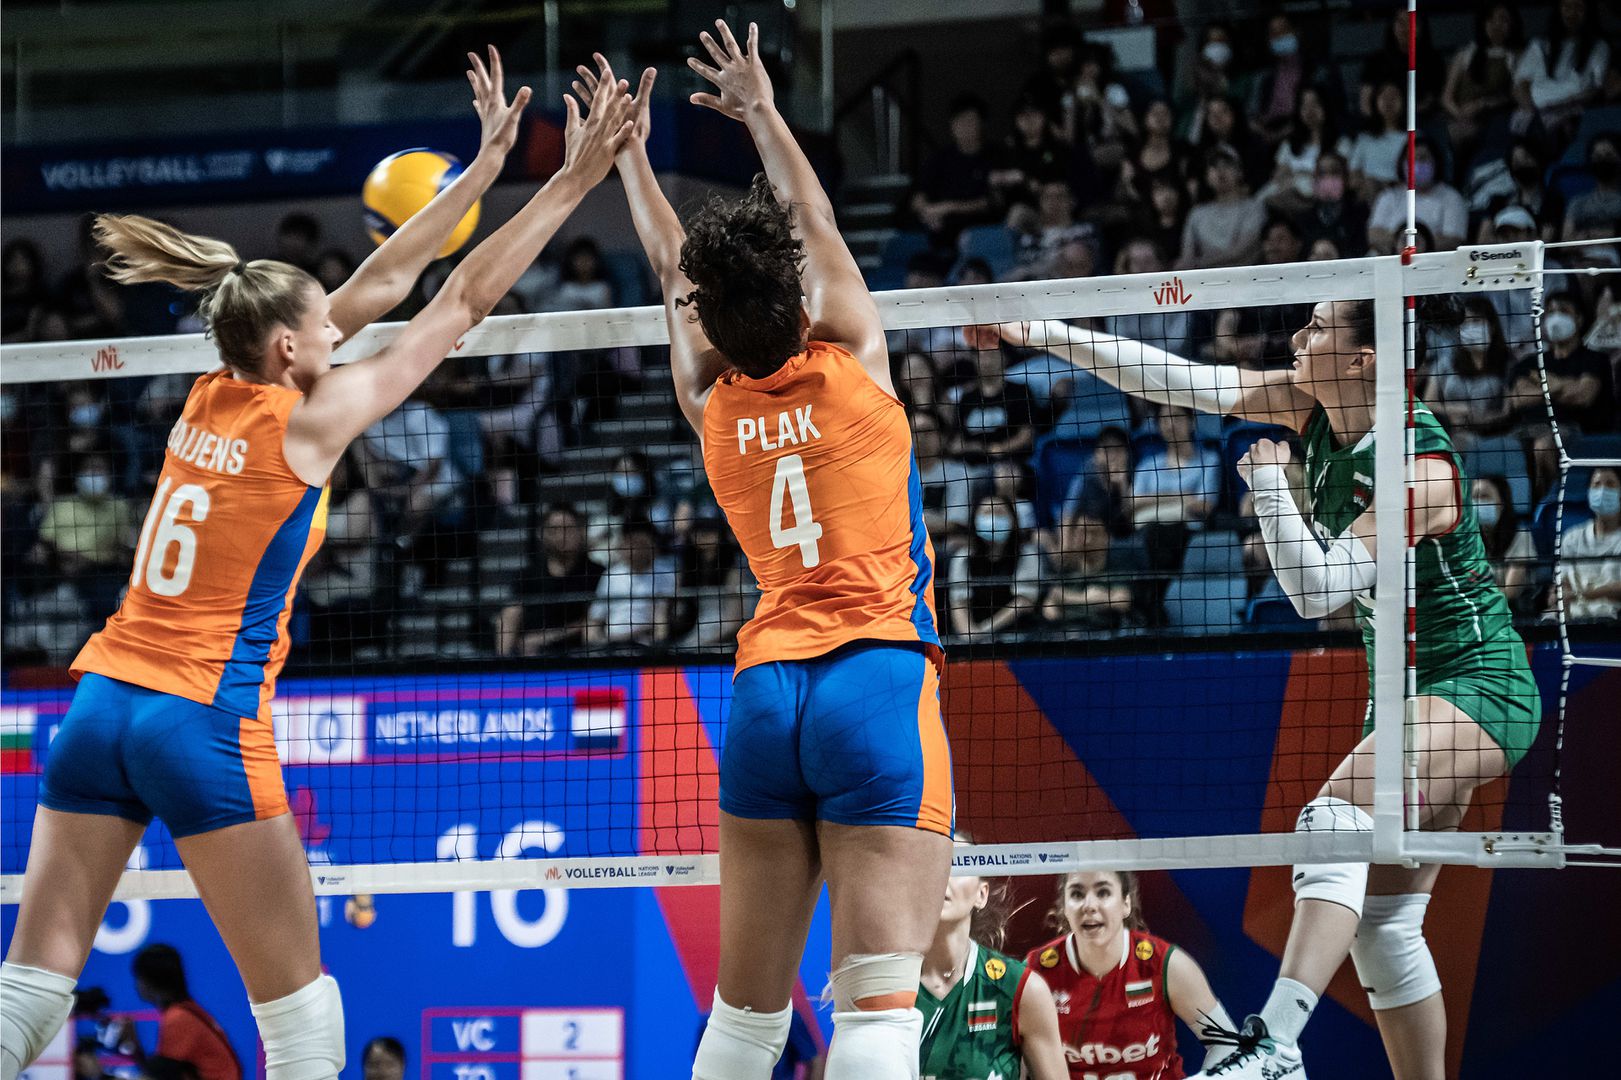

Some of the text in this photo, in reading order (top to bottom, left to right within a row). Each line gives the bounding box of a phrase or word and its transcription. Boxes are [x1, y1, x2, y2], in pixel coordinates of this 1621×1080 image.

[1480, 249, 1522, 261] Senoh
[1153, 276, 1192, 305] VNL
[91, 345, 125, 373] VNL
[737, 404, 822, 455] PLAK
[769, 454, 823, 568] 4
[131, 476, 211, 597] 16
[374, 708, 555, 745] NETHERLANDS
[436, 821, 569, 949] 16
[565, 867, 637, 879] VOLLEYBALL
[452, 1017, 578, 1051] VC 2
